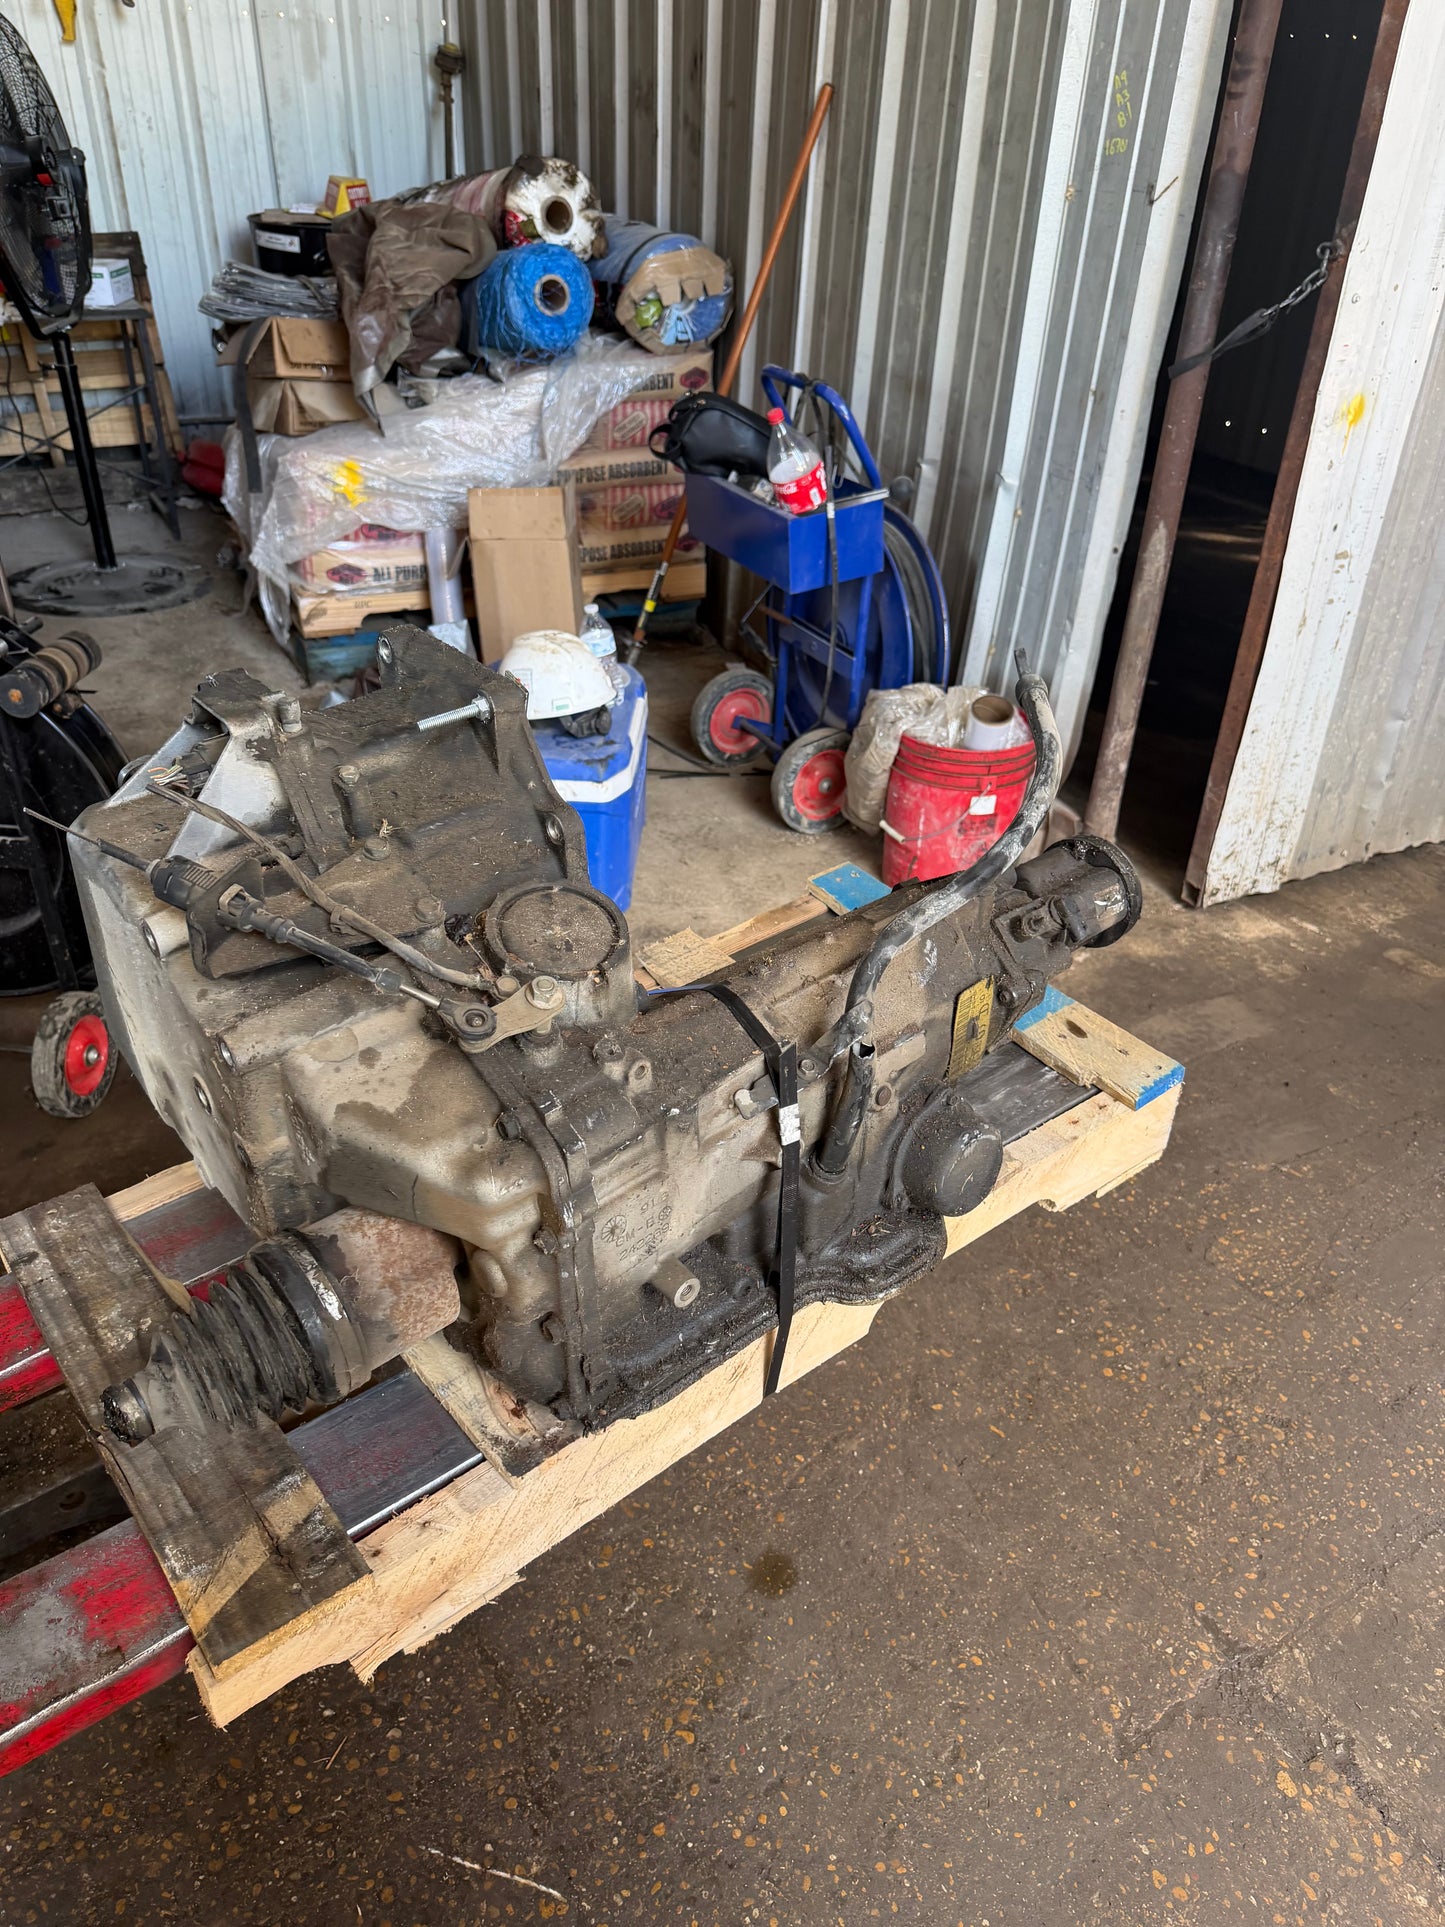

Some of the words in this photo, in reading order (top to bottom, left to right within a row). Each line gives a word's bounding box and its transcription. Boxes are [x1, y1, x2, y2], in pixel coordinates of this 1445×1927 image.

[608, 460, 668, 480] ABSORBENT
[373, 566, 391, 582] ALL
[395, 564, 426, 581] PURP
